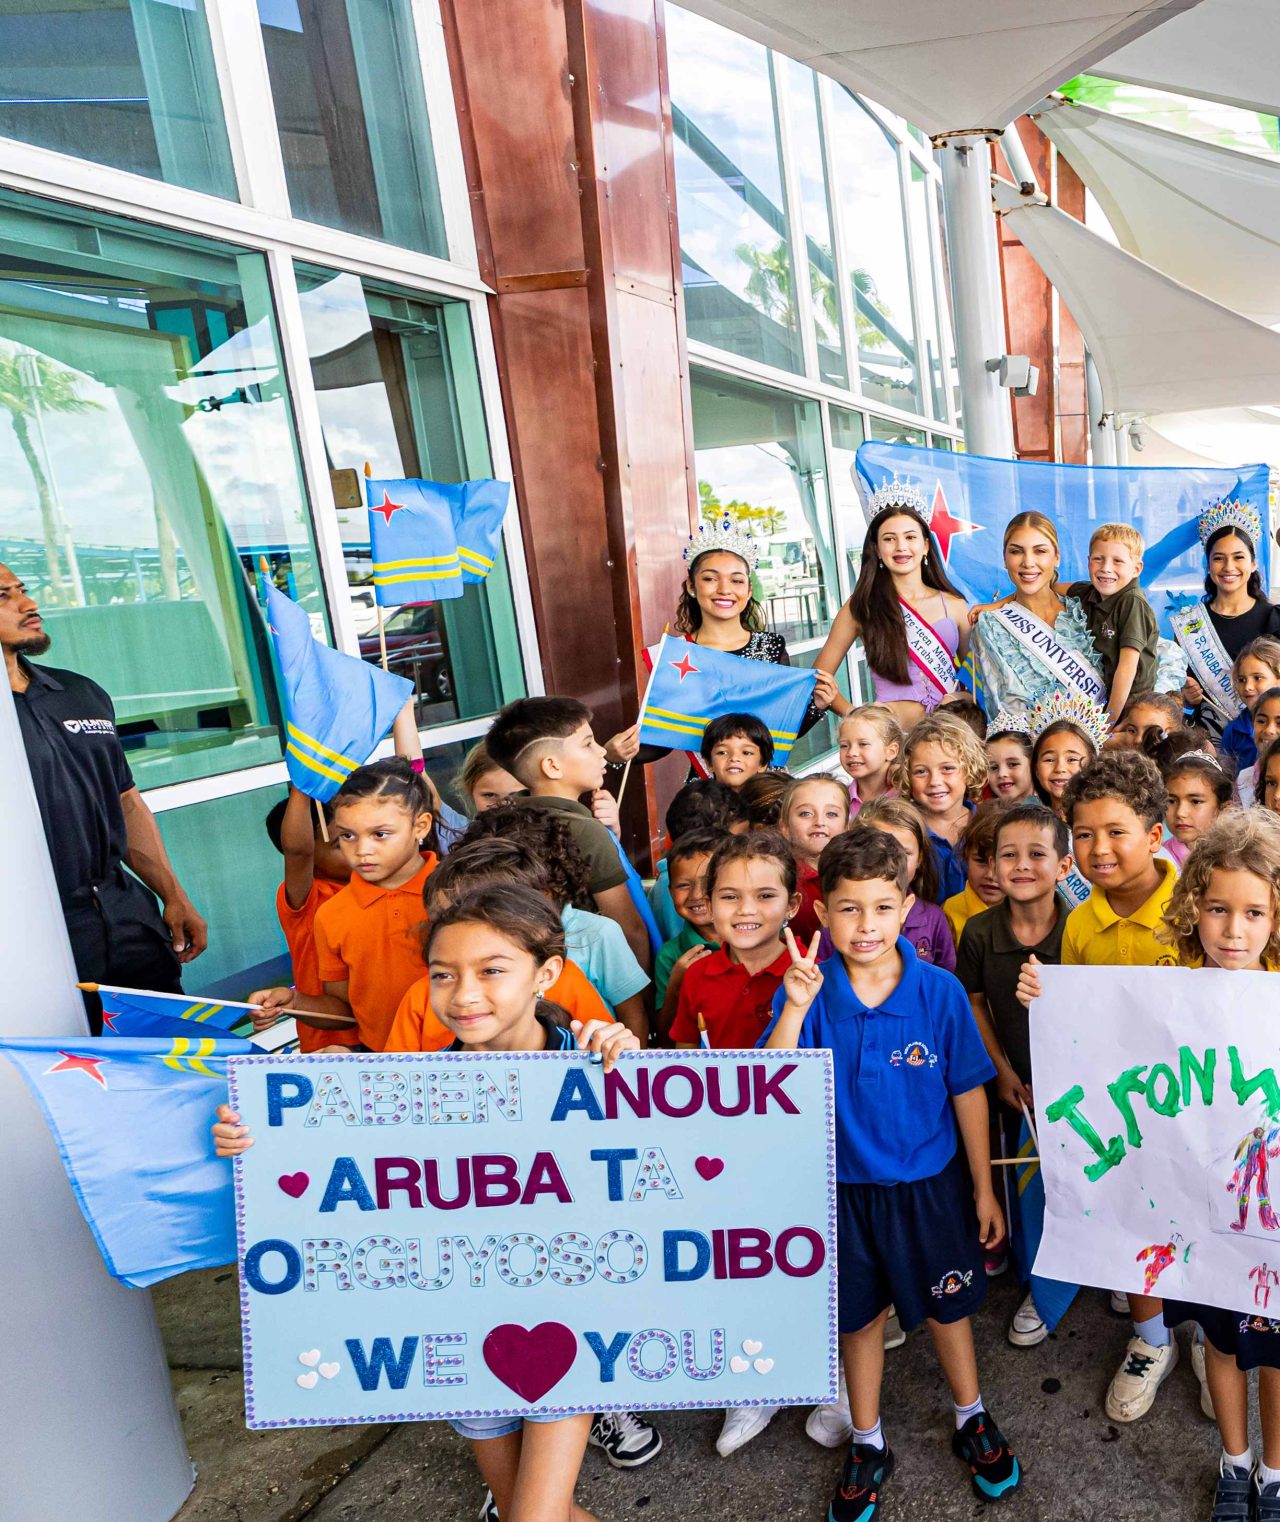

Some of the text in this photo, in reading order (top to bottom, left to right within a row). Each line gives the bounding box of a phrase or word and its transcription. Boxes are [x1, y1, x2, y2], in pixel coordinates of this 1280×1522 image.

[904, 613, 932, 646] Pre-teen
[933, 646, 948, 667] Miss
[911, 640, 949, 682] Aruba 2024
[1000, 608, 1101, 698] MISS UNIVERSE
[1200, 648, 1223, 677] ARUBA
[79, 719, 113, 728] HUNTER
[1065, 873, 1091, 901] ARUB
[266, 1063, 802, 1128] PABIEN ANOUK
[319, 1146, 684, 1213] ARUBA TA
[245, 1226, 827, 1296] ORGUYOSO DIBO
[345, 1328, 727, 1392] WE YOU
